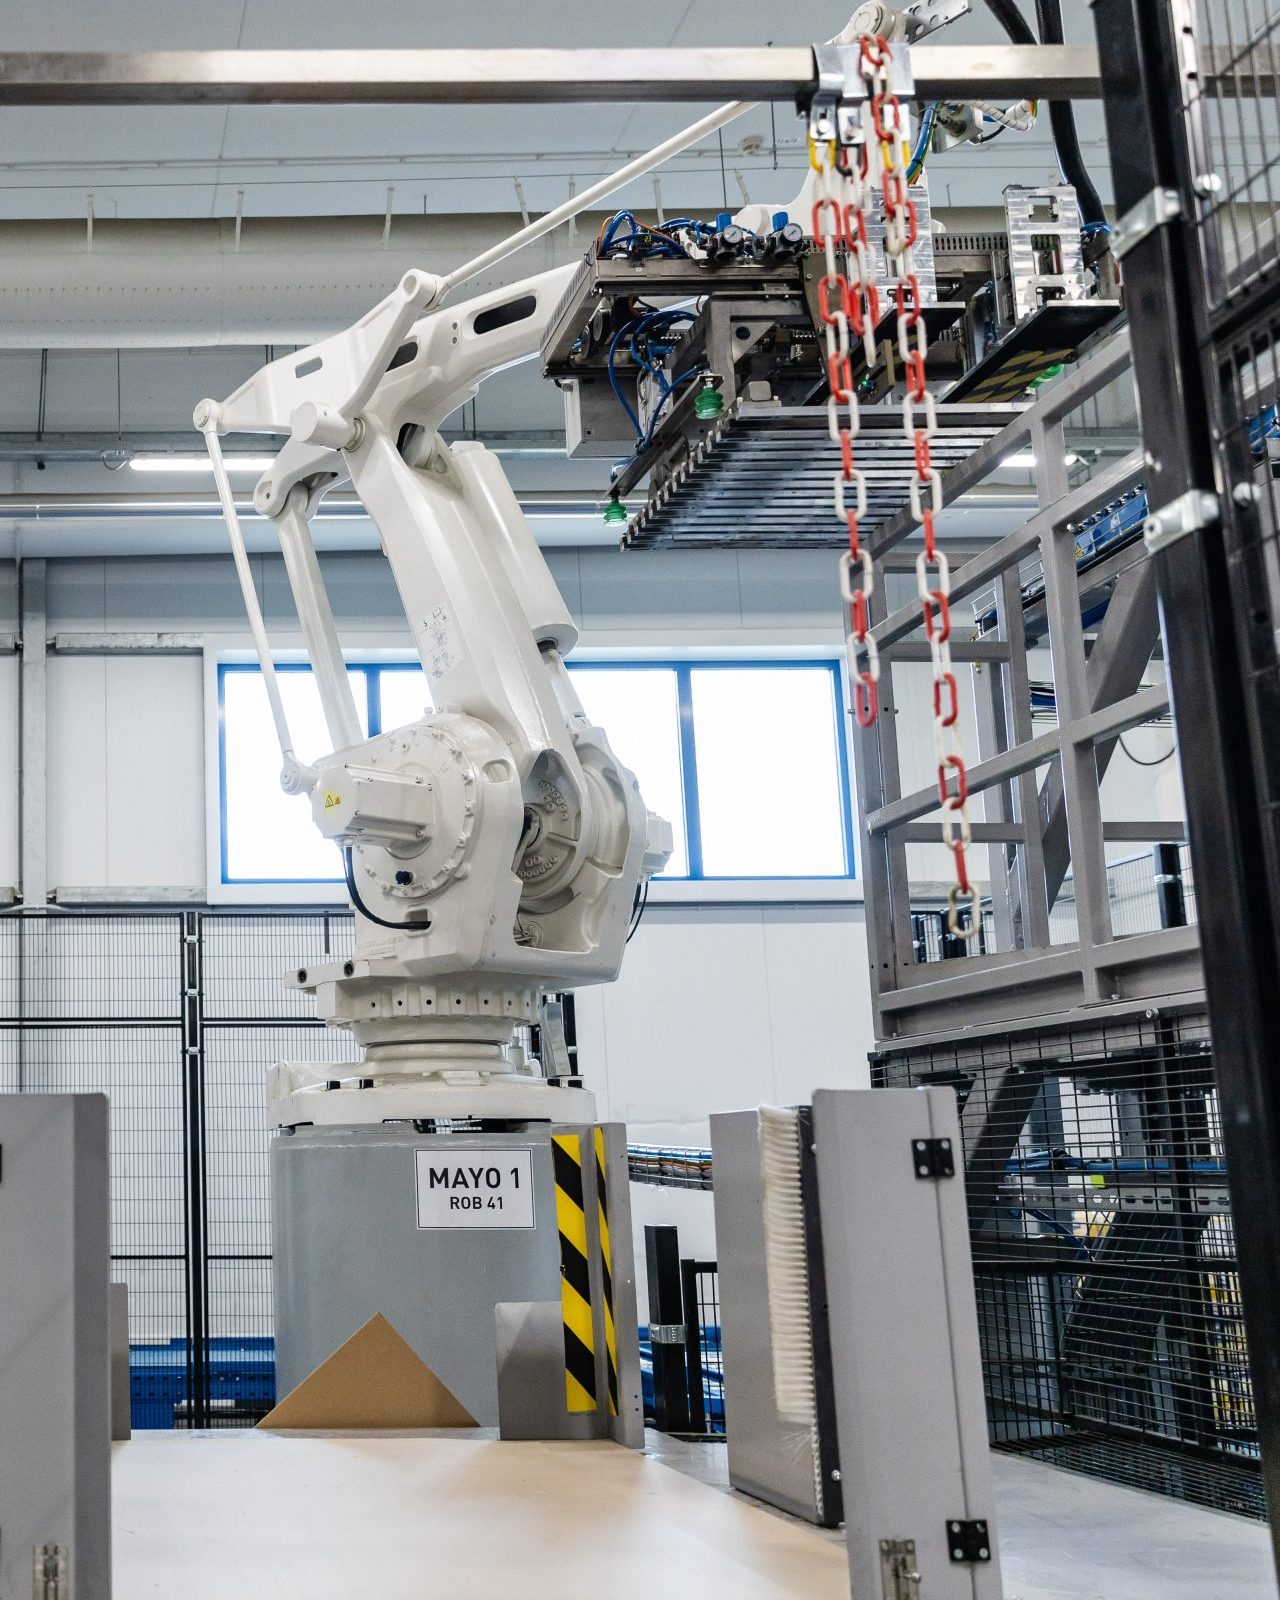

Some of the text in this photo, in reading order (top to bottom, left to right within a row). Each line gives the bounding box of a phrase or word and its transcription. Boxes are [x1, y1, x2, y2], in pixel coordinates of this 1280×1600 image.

[428, 1167, 520, 1189] MAYO 1
[449, 1196, 503, 1210] ROB 41
